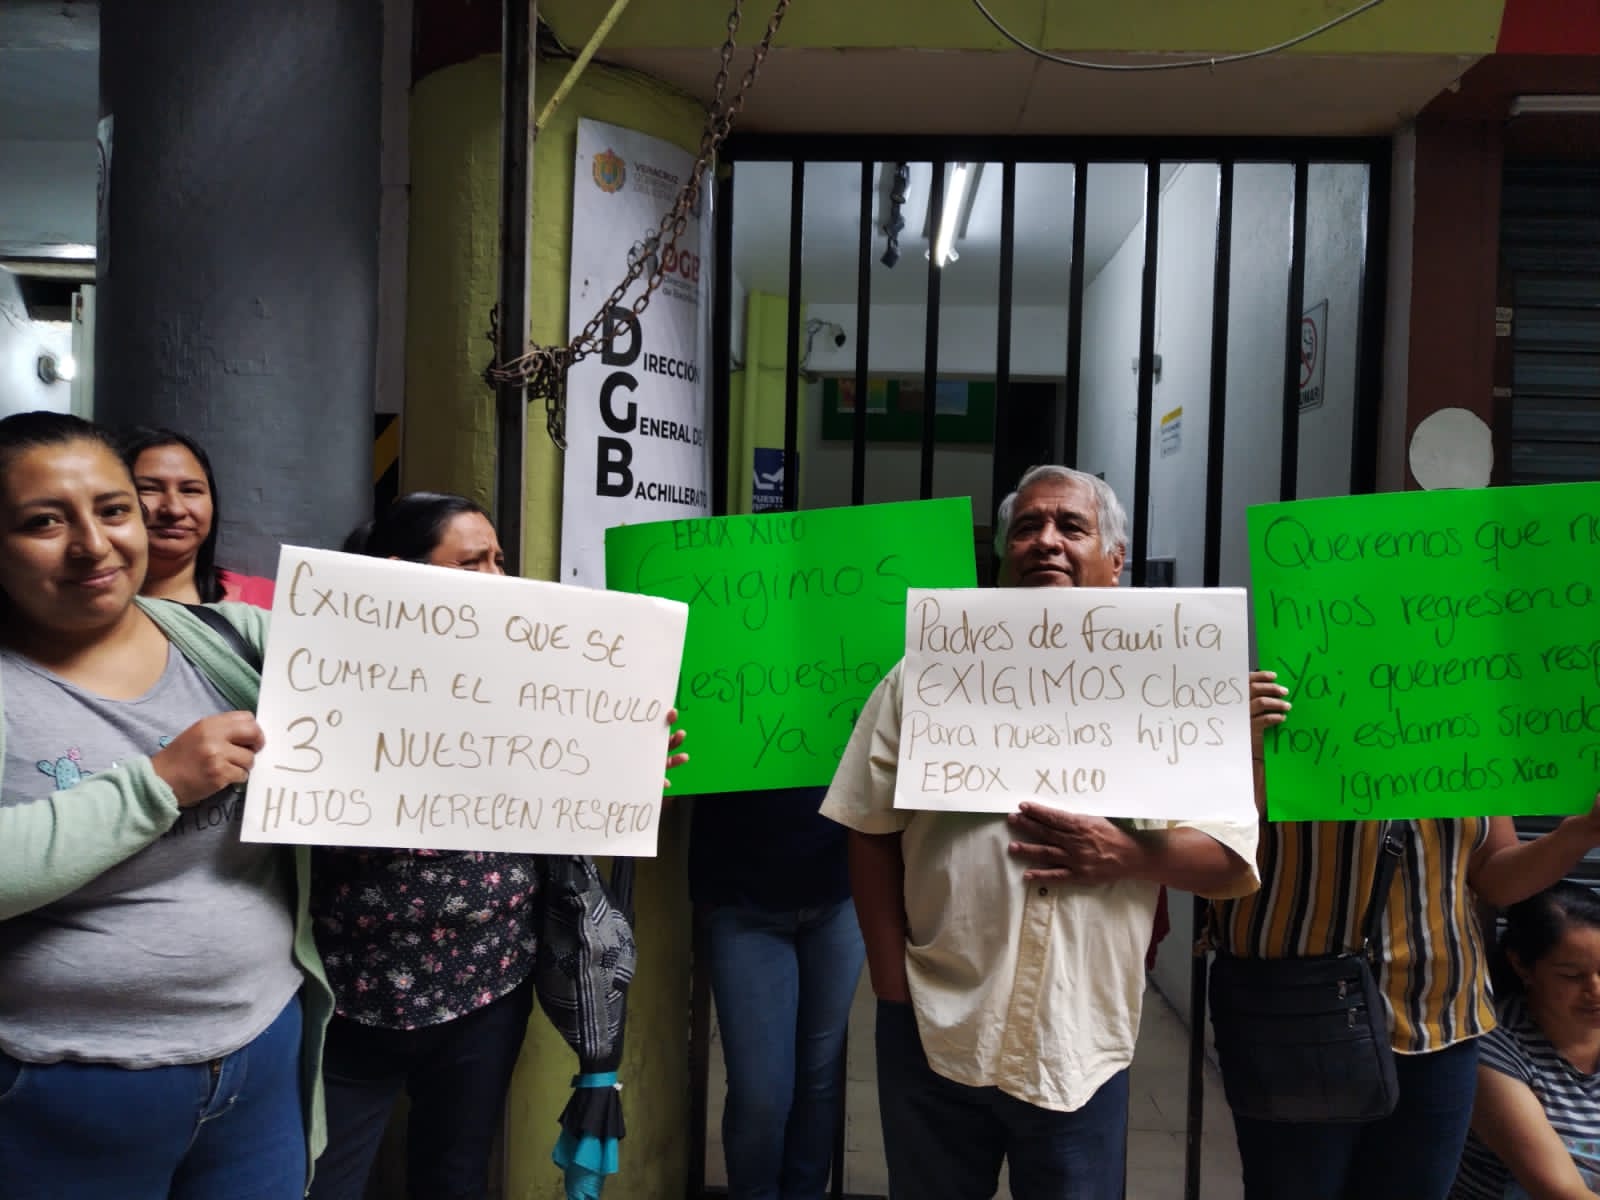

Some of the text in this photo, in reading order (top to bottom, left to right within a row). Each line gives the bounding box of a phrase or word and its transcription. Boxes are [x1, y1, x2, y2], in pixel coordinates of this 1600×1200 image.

[599, 371, 690, 443] GENERAL
[672, 515, 806, 551] EBOX XICO
[1264, 515, 1462, 570] Queremos
[1475, 519, 1551, 572] que
[289, 560, 627, 668] EXIGIMOS QUE SE
[914, 596, 1014, 655] Padres
[1028, 607, 1068, 650] de
[1269, 588, 1376, 654] hijos
[288, 647, 662, 724] CUMPLA EL ARTICULO
[917, 659, 1126, 709] EXIGIMOS
[1369, 652, 1522, 712] queremos
[374, 727, 591, 776] NUESTROS
[753, 712, 816, 768] Ya
[993, 712, 1112, 749] nuestros
[1137, 713, 1225, 765] hijos
[1354, 708, 1481, 750] estamos
[921, 761, 1106, 795] EBOX XICO
[1340, 752, 1504, 815] ignorados
[262, 787, 654, 838] HIJOS MERECEN RESPETO
